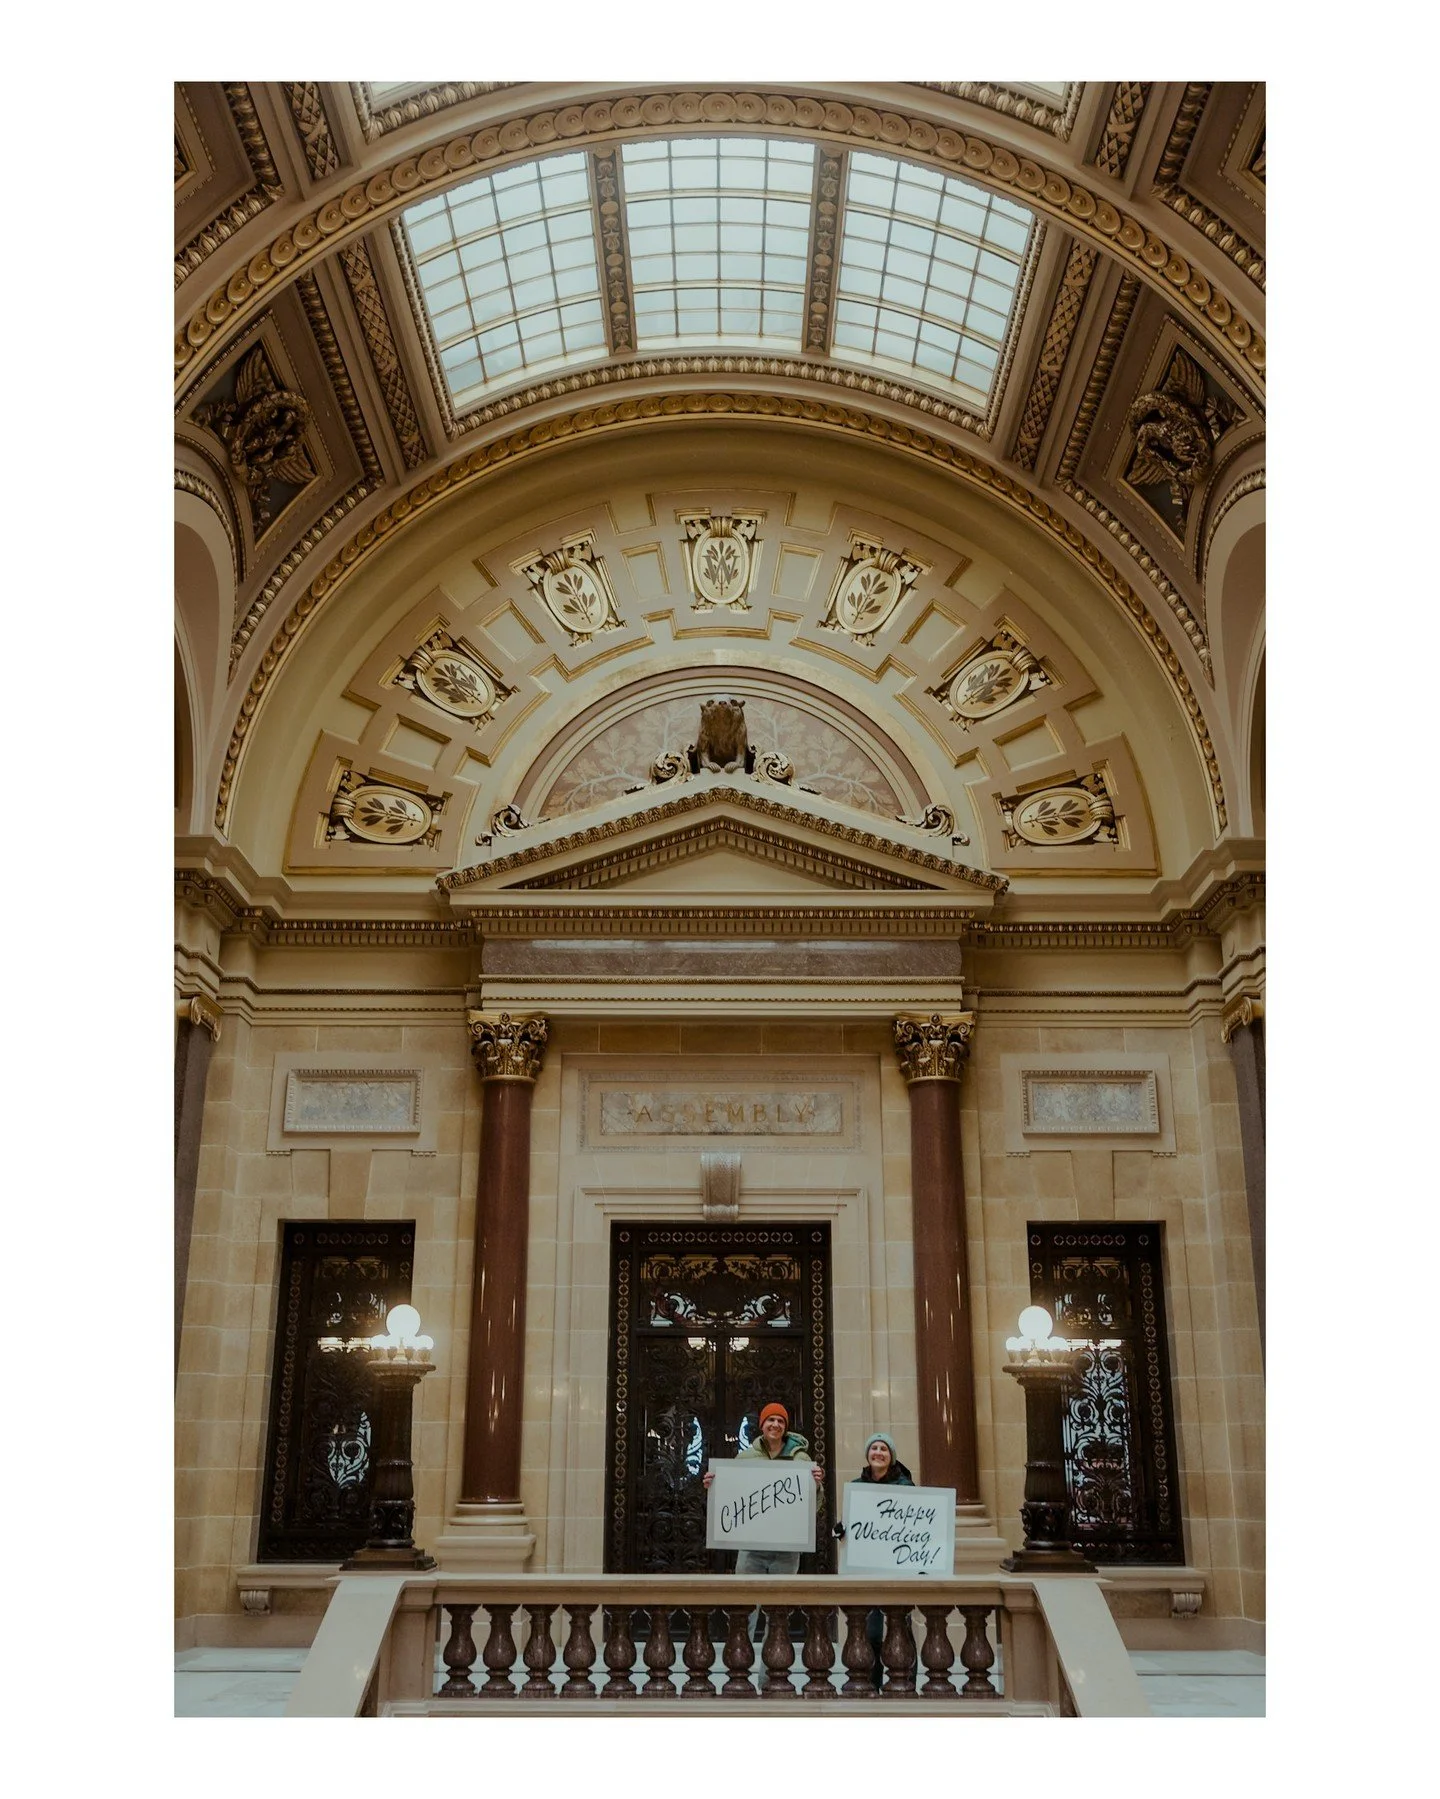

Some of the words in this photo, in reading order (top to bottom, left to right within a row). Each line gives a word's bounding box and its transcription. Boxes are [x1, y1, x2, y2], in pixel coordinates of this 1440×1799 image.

[702, 555, 741, 585] W
[635, 1103, 810, 1123] ASSEMBLY
[720, 1474, 803, 1533] CHEERS!
[877, 1499, 936, 1524] Happy
[851, 1522, 931, 1549] Wedding
[893, 1544, 940, 1566] Day!
